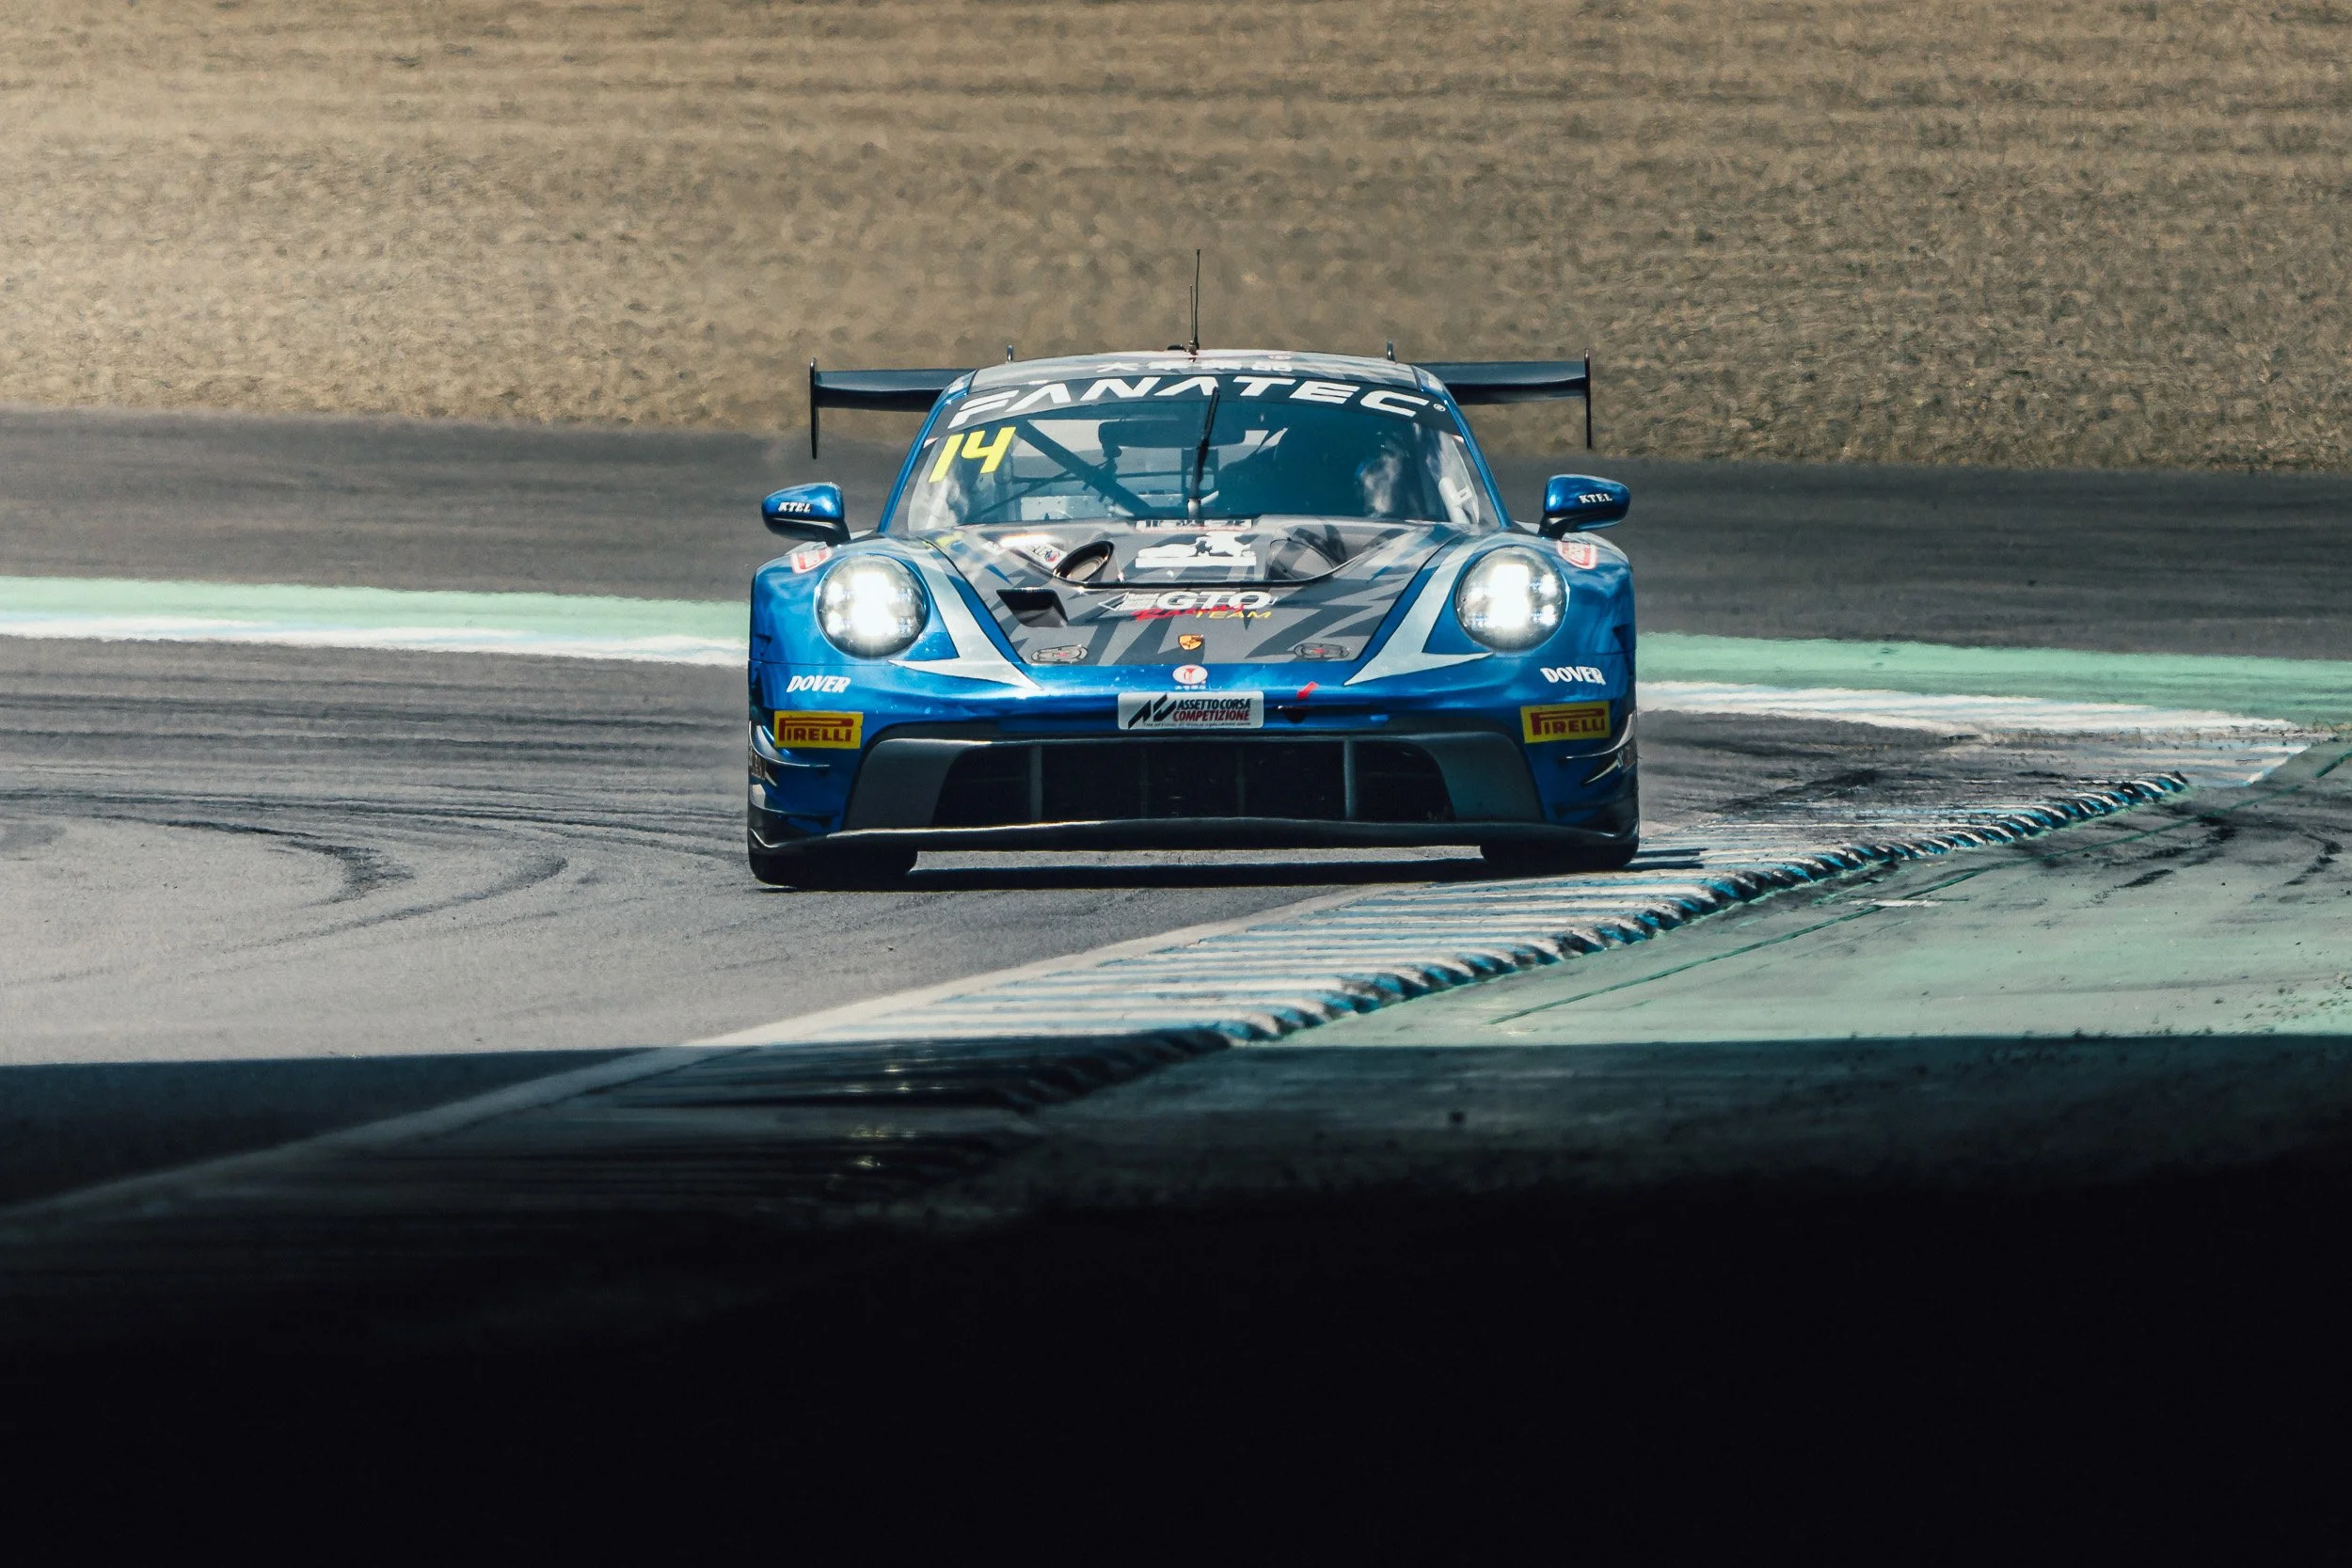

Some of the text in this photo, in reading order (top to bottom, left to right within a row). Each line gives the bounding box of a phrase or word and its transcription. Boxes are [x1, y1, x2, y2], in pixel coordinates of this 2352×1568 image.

[947, 376, 1429, 430] FANATEC
[929, 426, 1017, 483] 14
[778, 501, 812, 514] KTEL
[1579, 493, 1613, 504] KTEL
[1196, 610, 1272, 619] TEAM
[787, 675, 851, 693] DOVER
[1540, 666, 1606, 685] DOVER
[1176, 698, 1252, 710] ASSETTO CORSA
[1172, 710, 1250, 721] COMPETIZIONE
[1530, 707, 1606, 736] PIRELLI
[778, 717, 855, 742] PIRELLI
